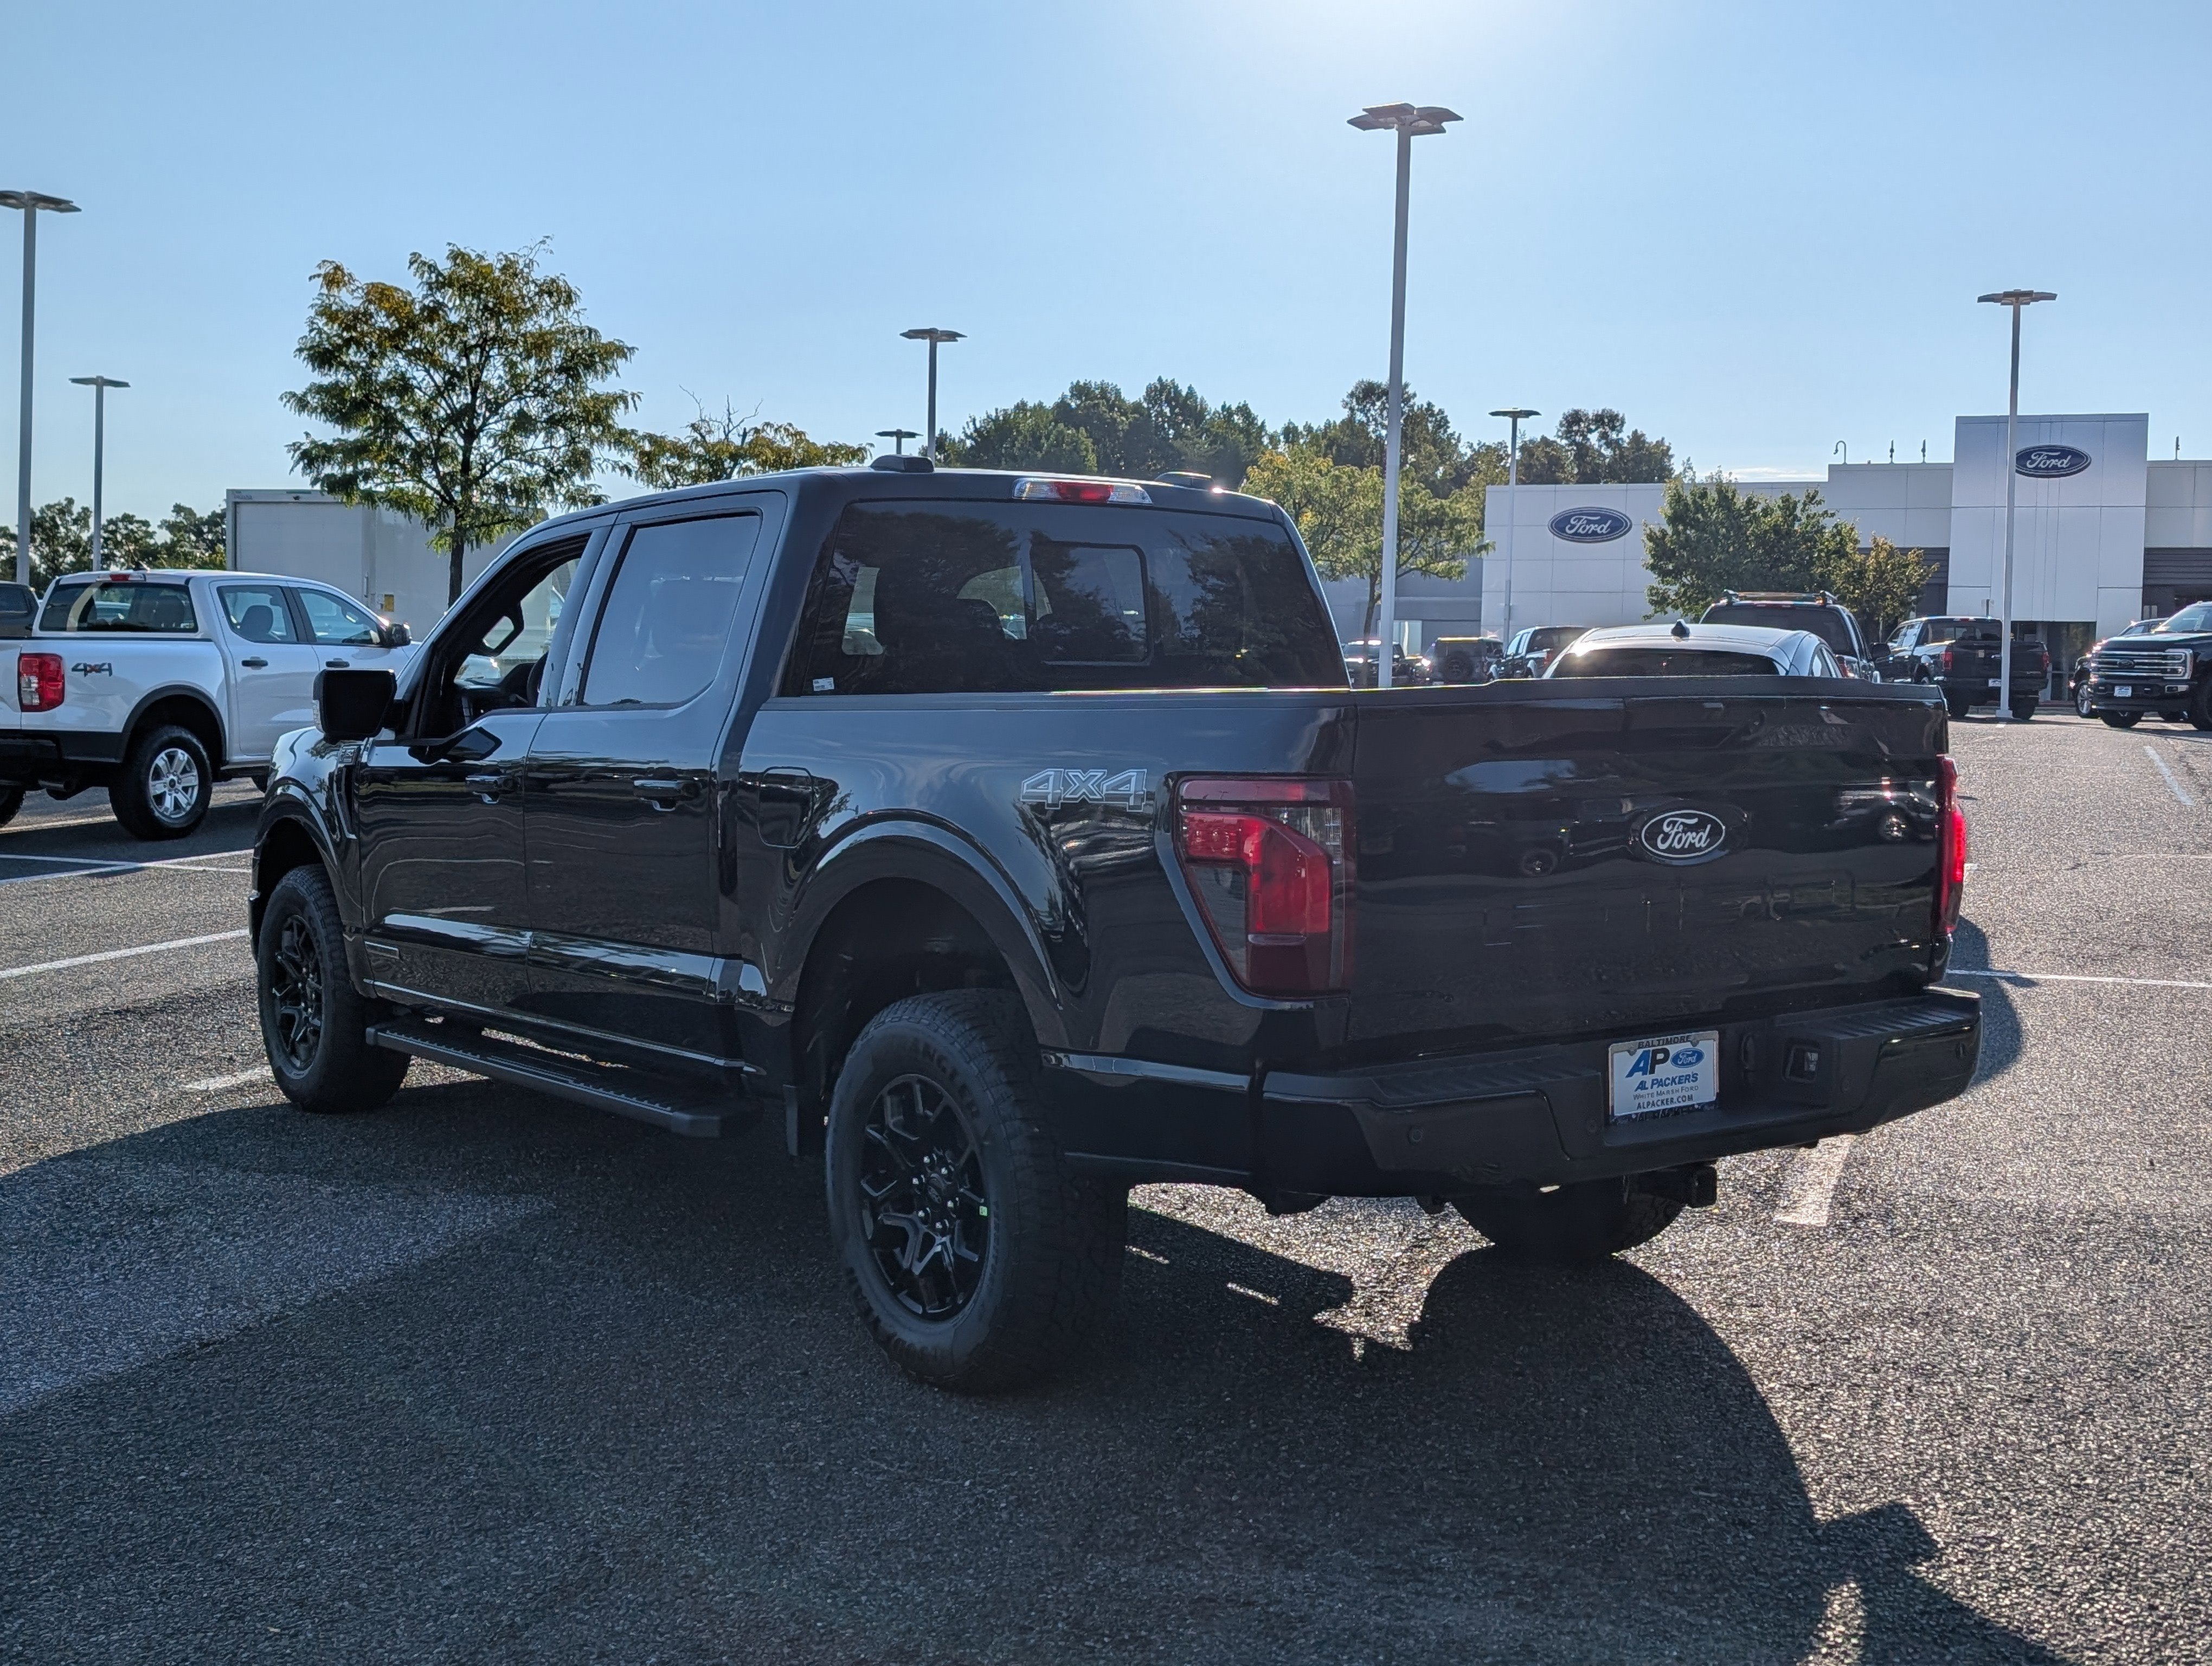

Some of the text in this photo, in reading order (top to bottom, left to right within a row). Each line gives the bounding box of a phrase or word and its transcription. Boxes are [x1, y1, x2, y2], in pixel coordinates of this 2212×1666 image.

[2026, 451, 2072, 469] Ford
[1565, 515, 1612, 534] Ford
[1657, 817, 1712, 850] Ford
[1637, 1035, 1692, 1049] BALTIMORE
[1677, 1050, 1698, 1064] Ford
[1634, 1070, 1699, 1092] AL PACKER'S
[1633, 1085, 1699, 1100] WHITE MARSH FORD
[1636, 1093, 1694, 1110] ALPACKER.COM
